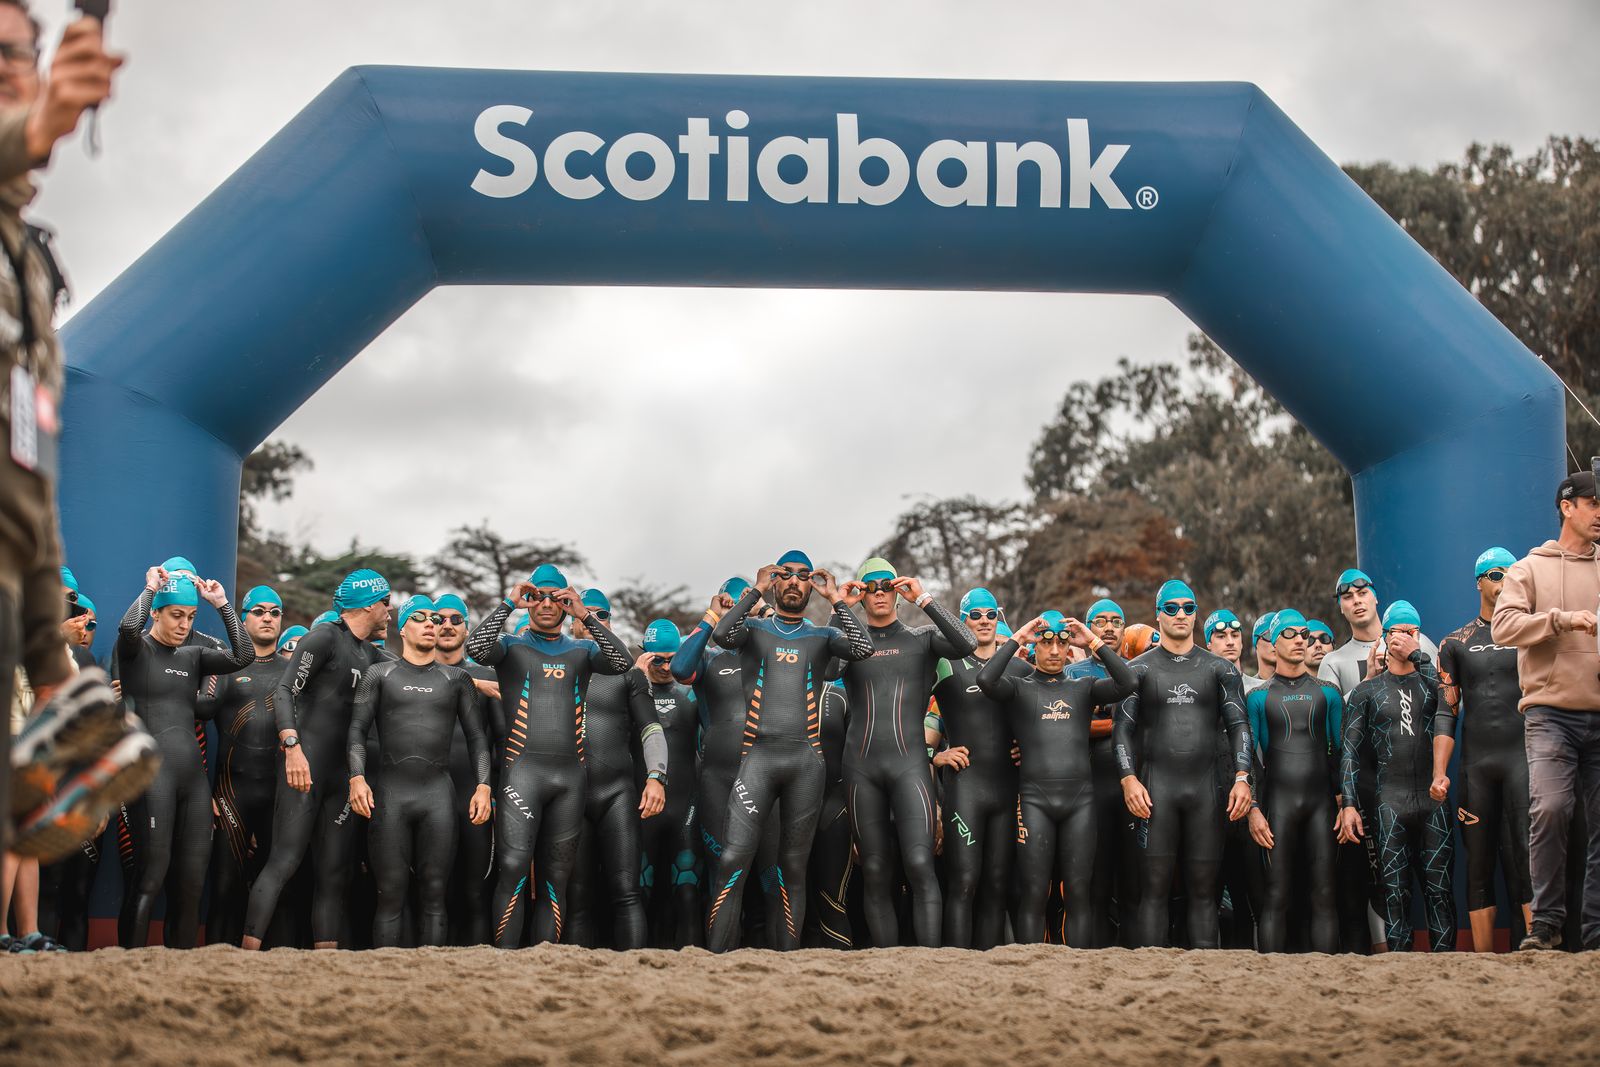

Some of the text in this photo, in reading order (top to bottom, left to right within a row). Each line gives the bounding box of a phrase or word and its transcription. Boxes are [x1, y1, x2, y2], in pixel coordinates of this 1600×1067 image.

[470, 104, 1134, 210] Scotiabank
[776, 653, 799, 664] 70
[164, 668, 189, 677] orca
[543, 669, 566, 679] 70
[718, 668, 742, 676] or
[403, 685, 433, 693] orca
[1041, 711, 1071, 722] sailfish
[734, 778, 760, 815] HELIX
[503, 785, 535, 820] HELIX
